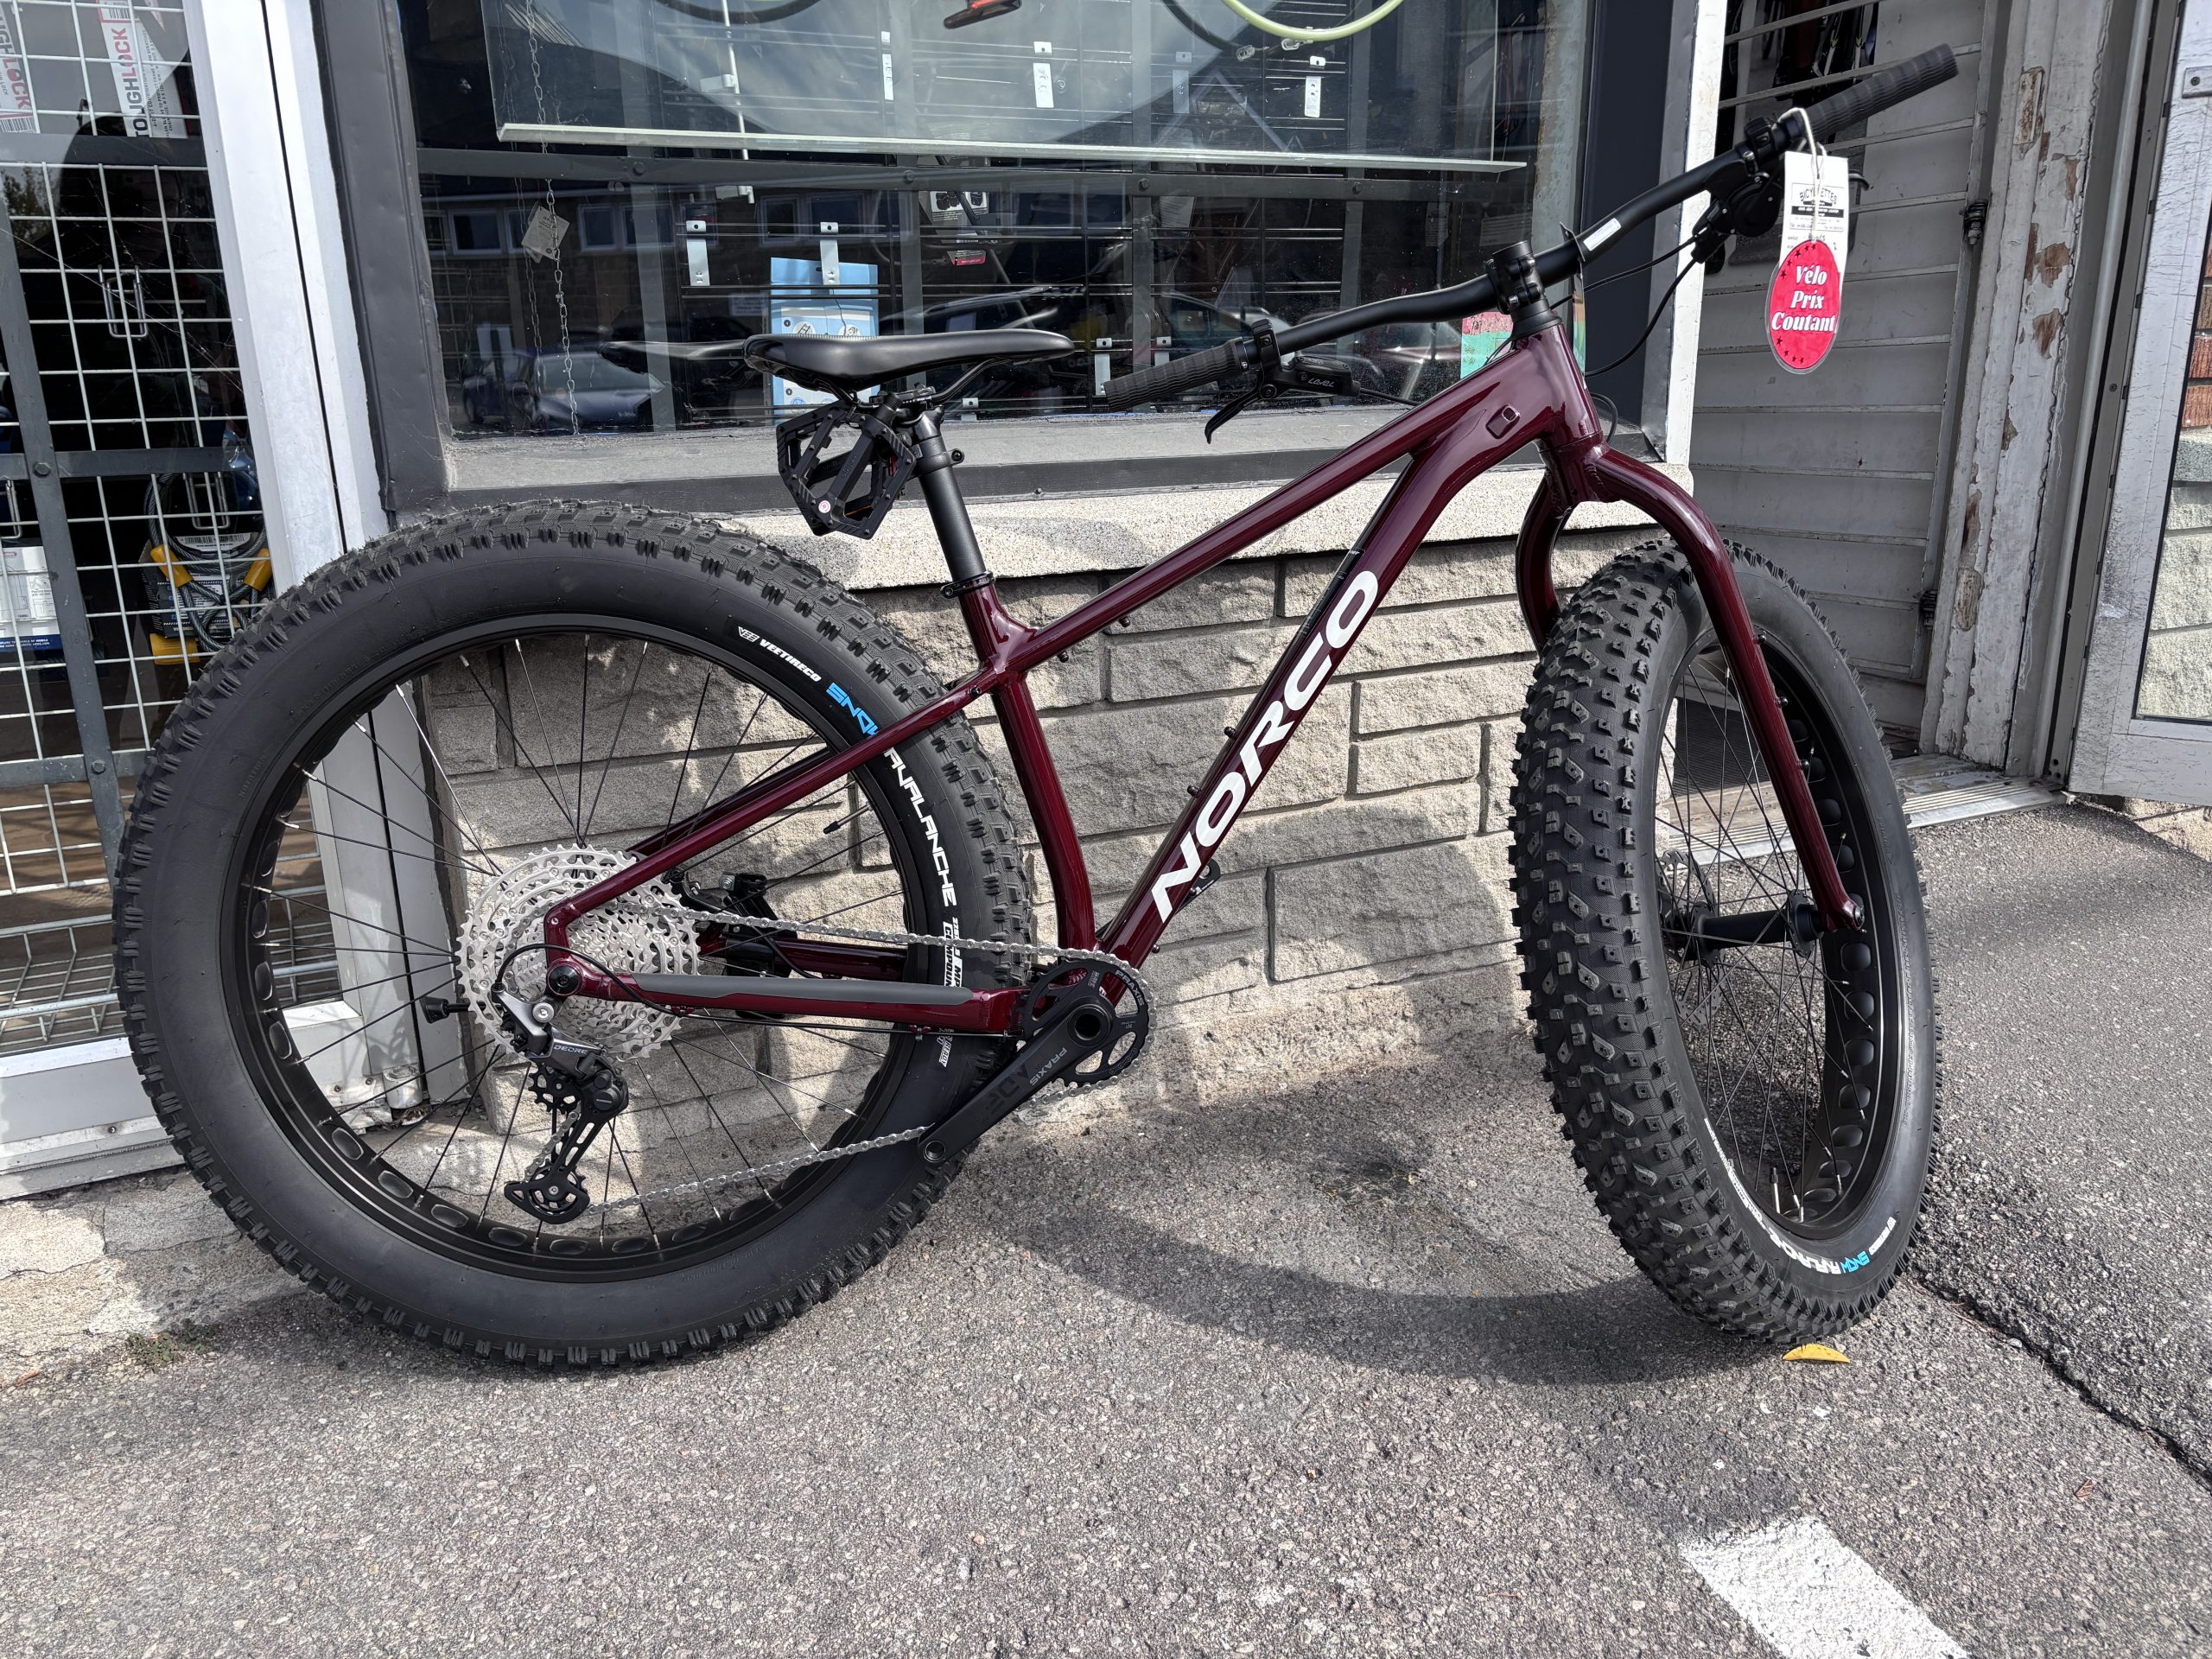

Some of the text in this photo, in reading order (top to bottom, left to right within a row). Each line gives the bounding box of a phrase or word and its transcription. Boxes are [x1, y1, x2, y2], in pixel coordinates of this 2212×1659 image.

[1800, 188, 1837, 205] BICYETTES
[1796, 264, 1827, 286] Vélo
[1789, 289, 1825, 309] Prix
[1771, 311, 1836, 332] Coutant
[759, 638, 822, 683] VEETIRECO
[1151, 570, 1378, 923] NORCO
[882, 746, 957, 907] AVALANCHE
[553, 1045, 588, 1055] DEORE
[1029, 1047, 1068, 1086] PRAXIS
